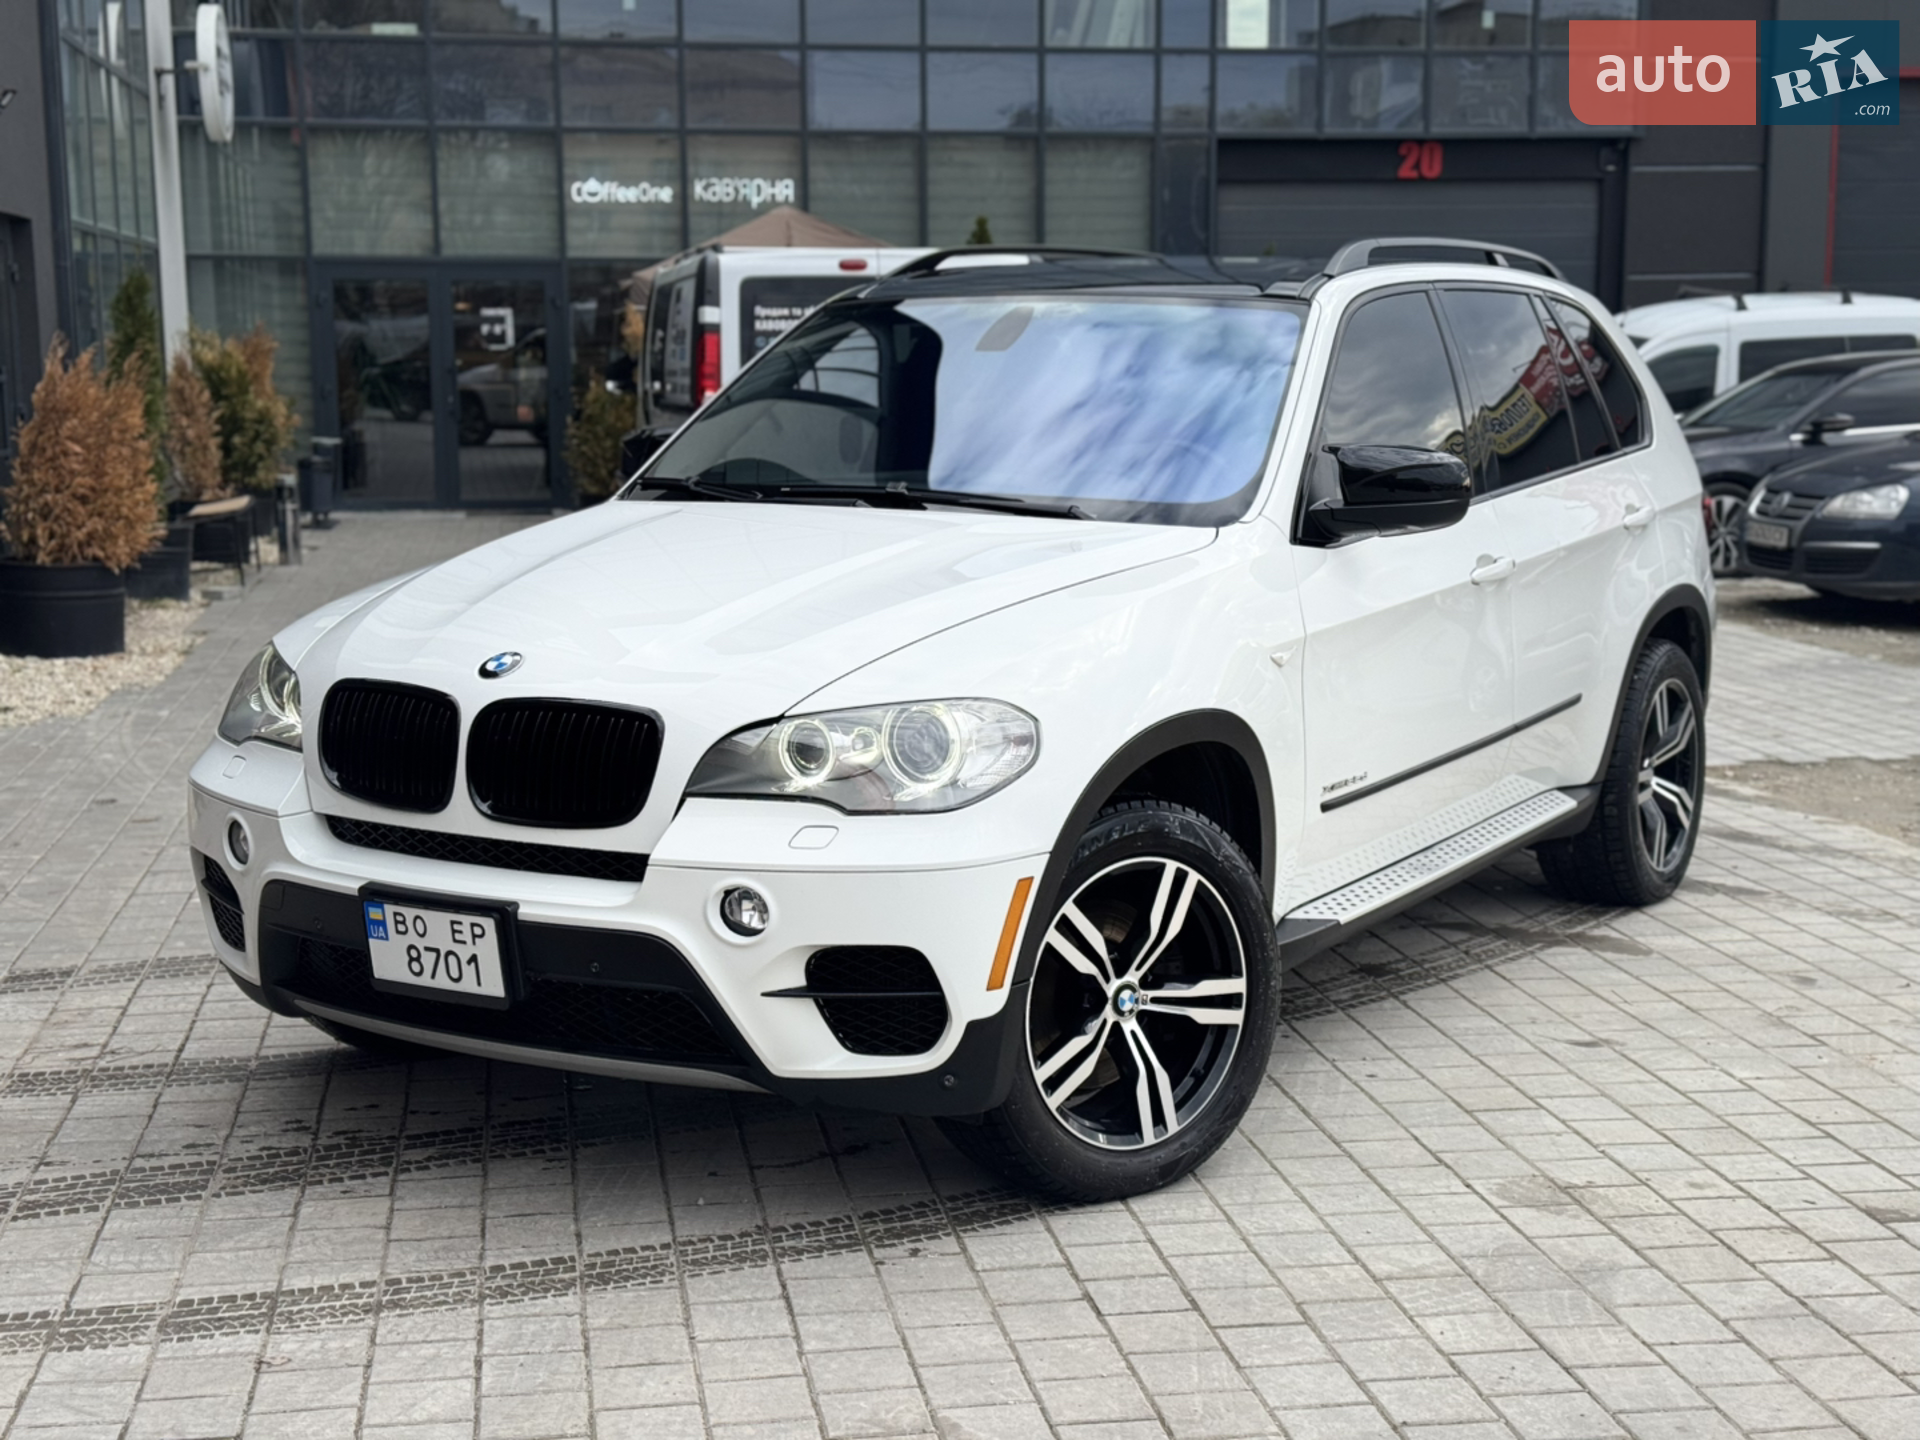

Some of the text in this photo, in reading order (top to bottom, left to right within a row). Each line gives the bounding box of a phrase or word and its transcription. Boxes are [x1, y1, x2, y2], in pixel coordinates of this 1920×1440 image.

[1397, 141, 1444, 180] 20
[370, 924, 387, 939] UA
[393, 911, 487, 946] BO EP
[406, 943, 482, 988] 8701
